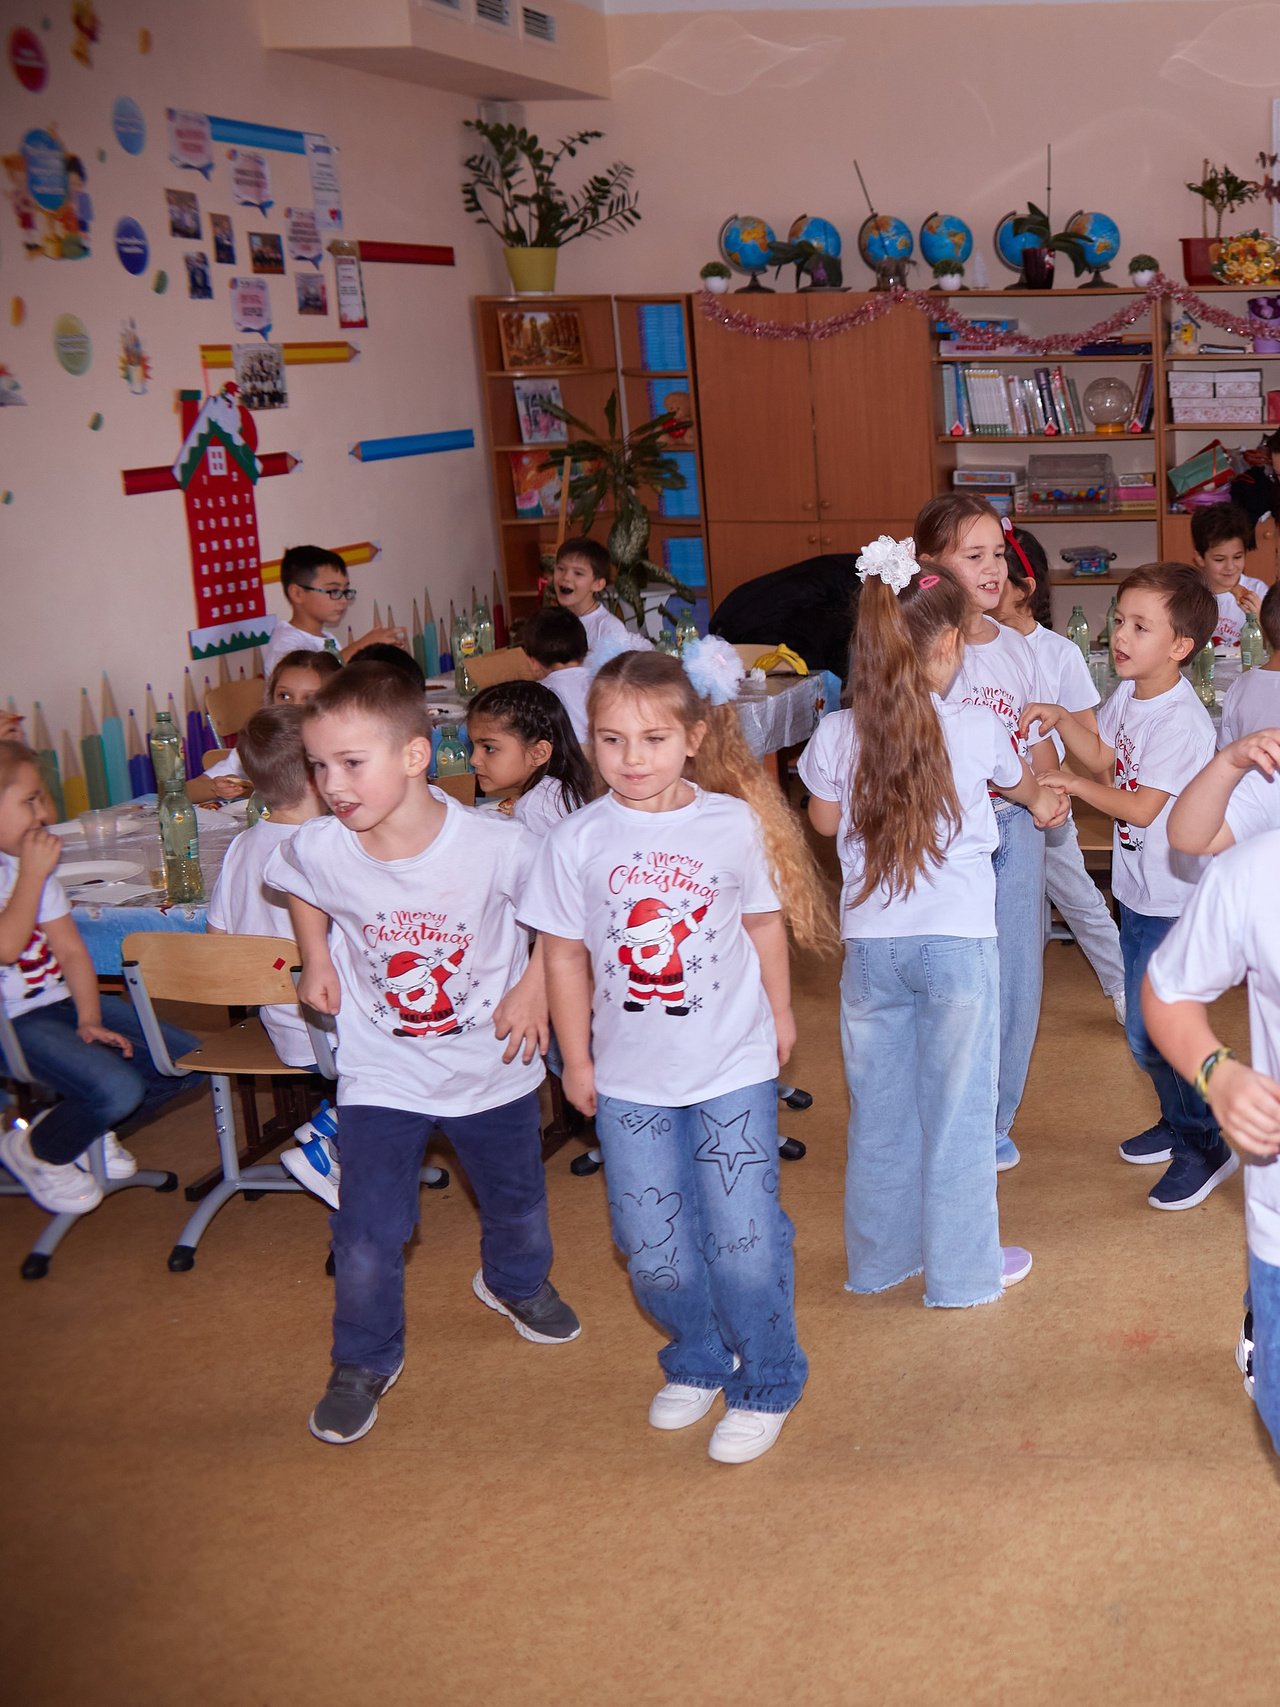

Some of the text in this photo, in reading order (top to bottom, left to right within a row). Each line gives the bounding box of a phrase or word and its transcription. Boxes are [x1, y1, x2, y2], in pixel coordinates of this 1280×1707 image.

[980, 686, 1014, 705] Merry
[646, 851, 704, 875] Merry
[608, 864, 720, 907] Christmas
[390, 910, 447, 928] Merry
[362, 922, 474, 951] Christmas
[702, 1218, 762, 1266] Crush
